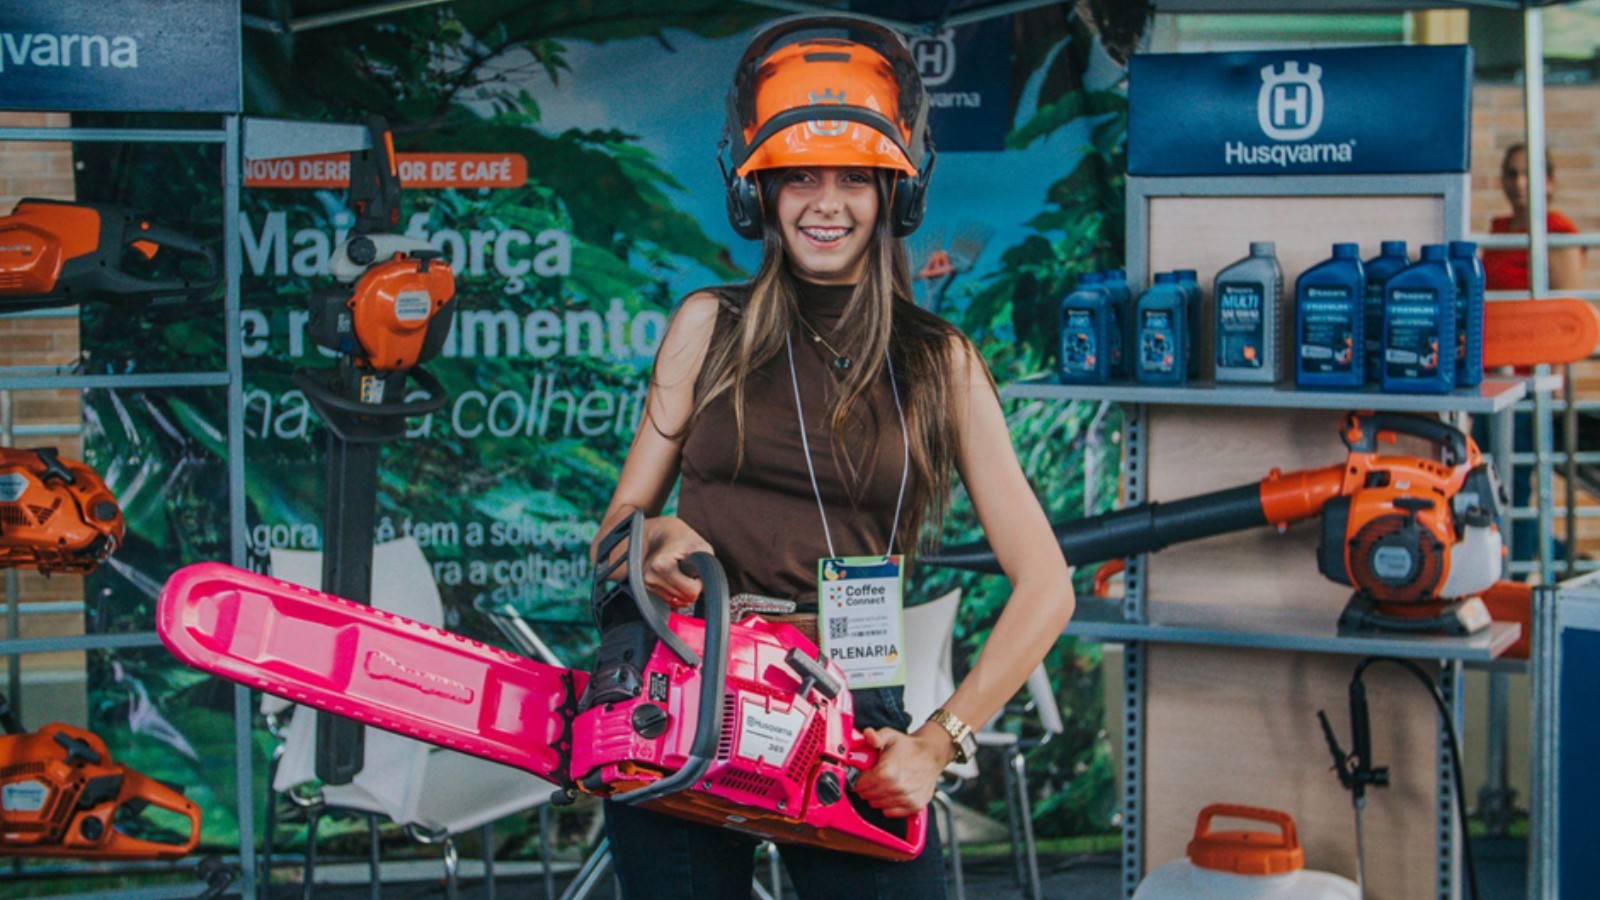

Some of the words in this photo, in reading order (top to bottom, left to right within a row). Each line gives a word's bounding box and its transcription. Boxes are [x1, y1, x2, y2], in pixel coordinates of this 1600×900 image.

[1225, 141, 1352, 167] Husqvarna
[244, 159, 294, 180] NOVO
[431, 162, 456, 181] DE
[461, 158, 511, 181] CAFÉ
[240, 309, 269, 357] e
[452, 373, 645, 438] colheit
[465, 521, 484, 547] a
[490, 514, 599, 552] solução
[468, 560, 487, 585] a
[493, 553, 592, 585] colheit
[845, 584, 886, 597] Coffee
[845, 596, 886, 606] Connect
[830, 644, 899, 660] PLENARIA
